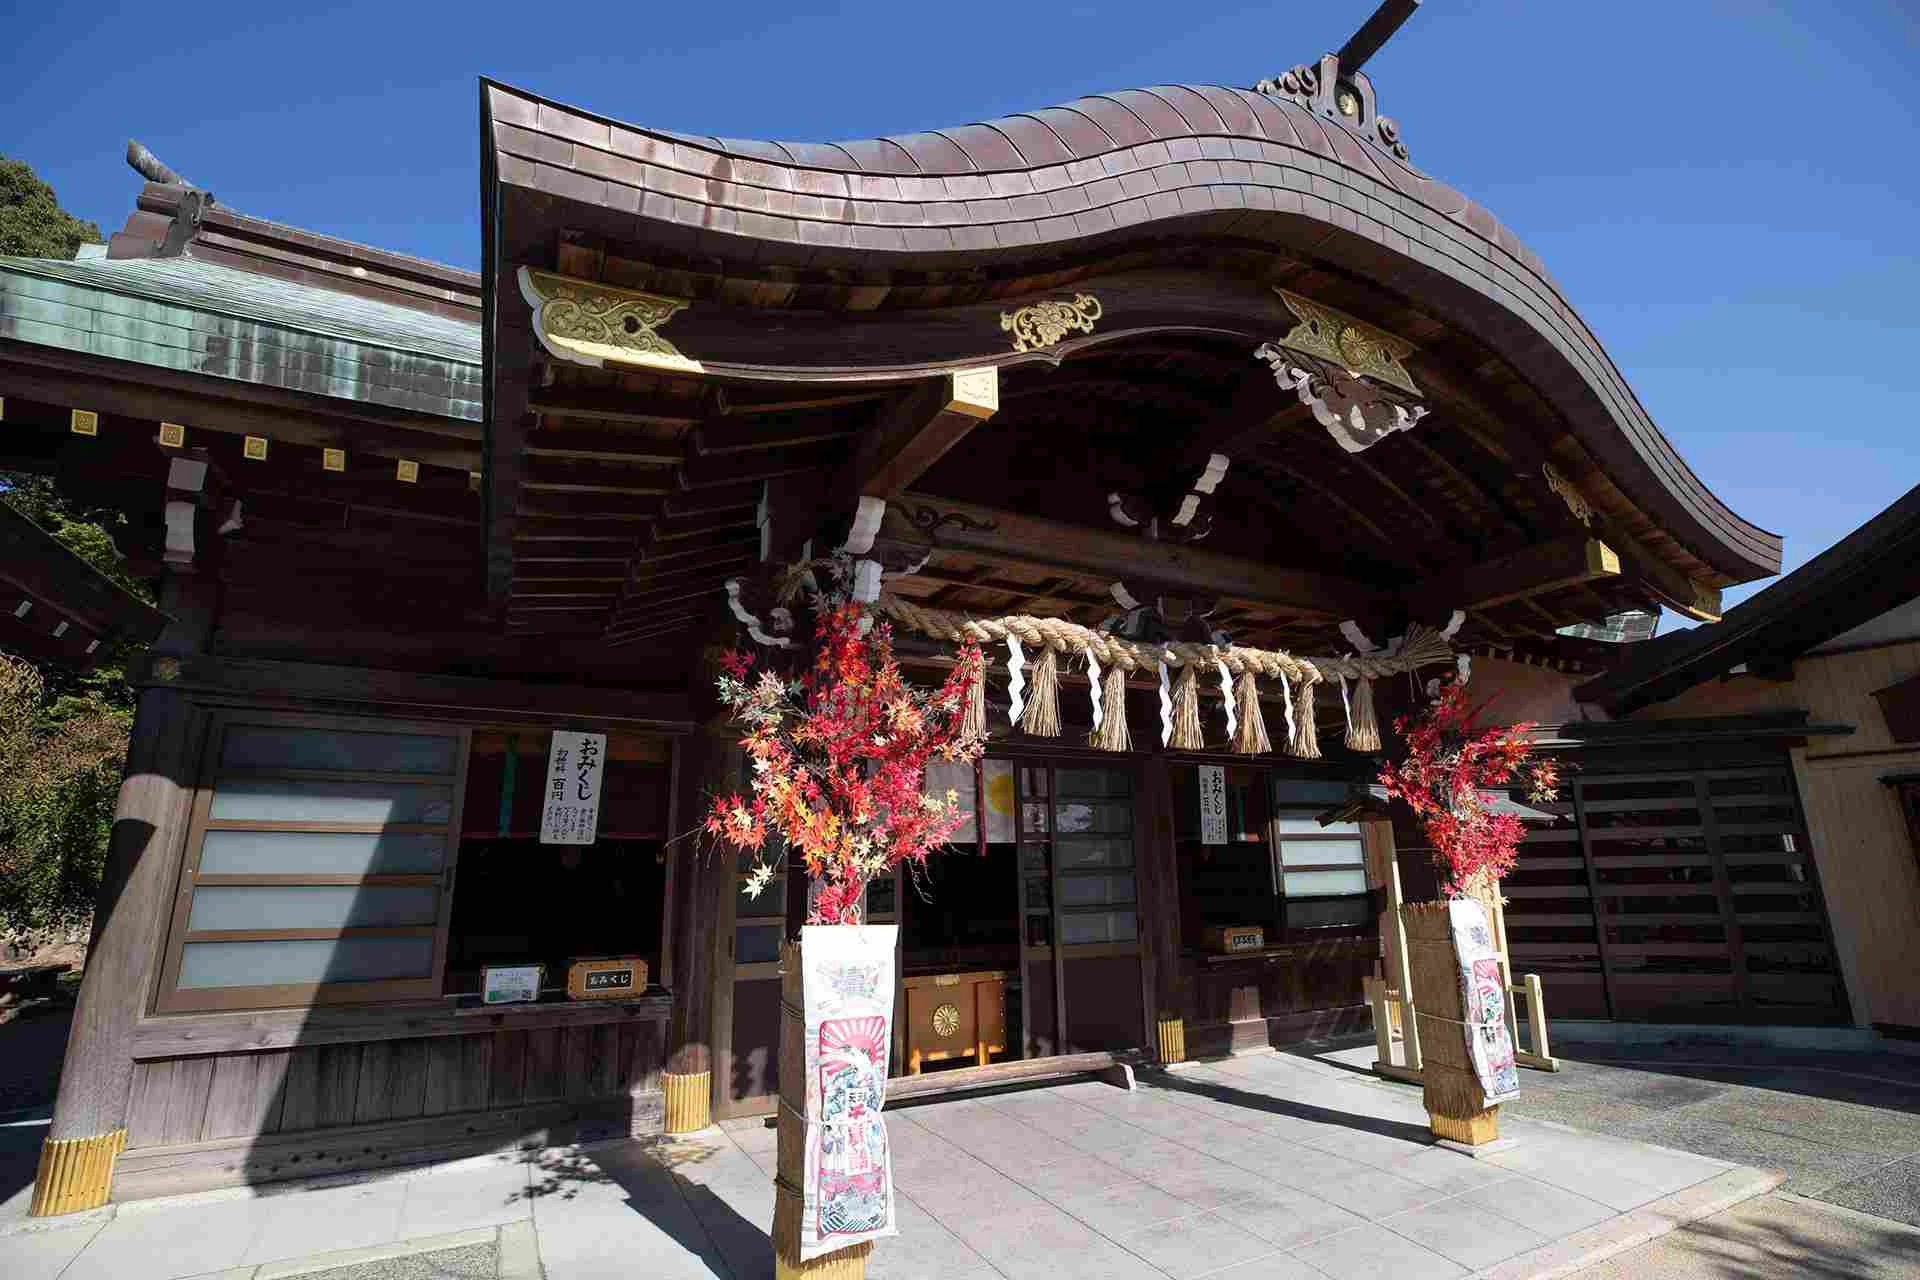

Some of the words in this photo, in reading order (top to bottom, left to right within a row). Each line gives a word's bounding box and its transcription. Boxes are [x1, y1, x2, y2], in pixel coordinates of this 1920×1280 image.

[577, 738, 599, 801] おみくじ
[1212, 769, 1223, 815] おみくじ
